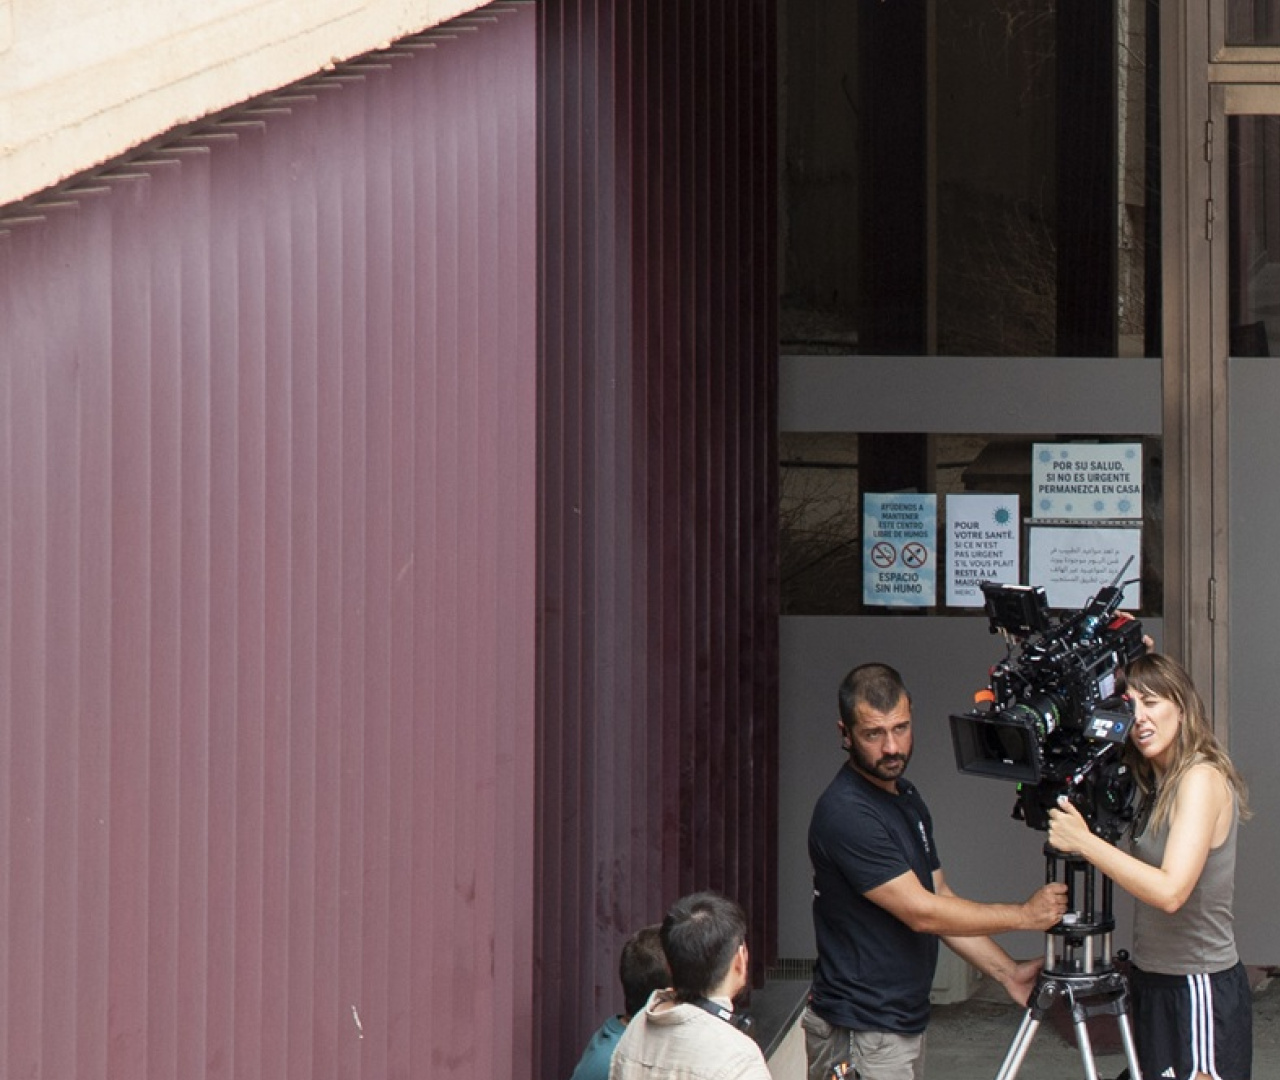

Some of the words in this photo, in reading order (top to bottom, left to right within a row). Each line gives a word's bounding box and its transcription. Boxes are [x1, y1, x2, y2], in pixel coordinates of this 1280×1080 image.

[1053, 461, 1072, 470] POR
[1074, 461, 1088, 470] SU
[1090, 461, 1124, 471] SALUD,
[1046, 473, 1055, 482] SI
[1058, 473, 1071, 482] NO
[1073, 473, 1085, 482] ES
[1087, 473, 1130, 482] URGENTE
[1038, 485, 1100, 494] PERMANEZCA
[1102, 485, 1114, 494] EN
[1116, 485, 1140, 494] CASA
[954, 521, 980, 530] POUR
[954, 531, 982, 539] VOTRE
[878, 573, 919, 582] ESPACIO
[954, 569, 978, 577] RESTE
[987, 569, 997, 577] LA
[875, 584, 891, 593] SIN
[893, 584, 922, 593] HUMO
